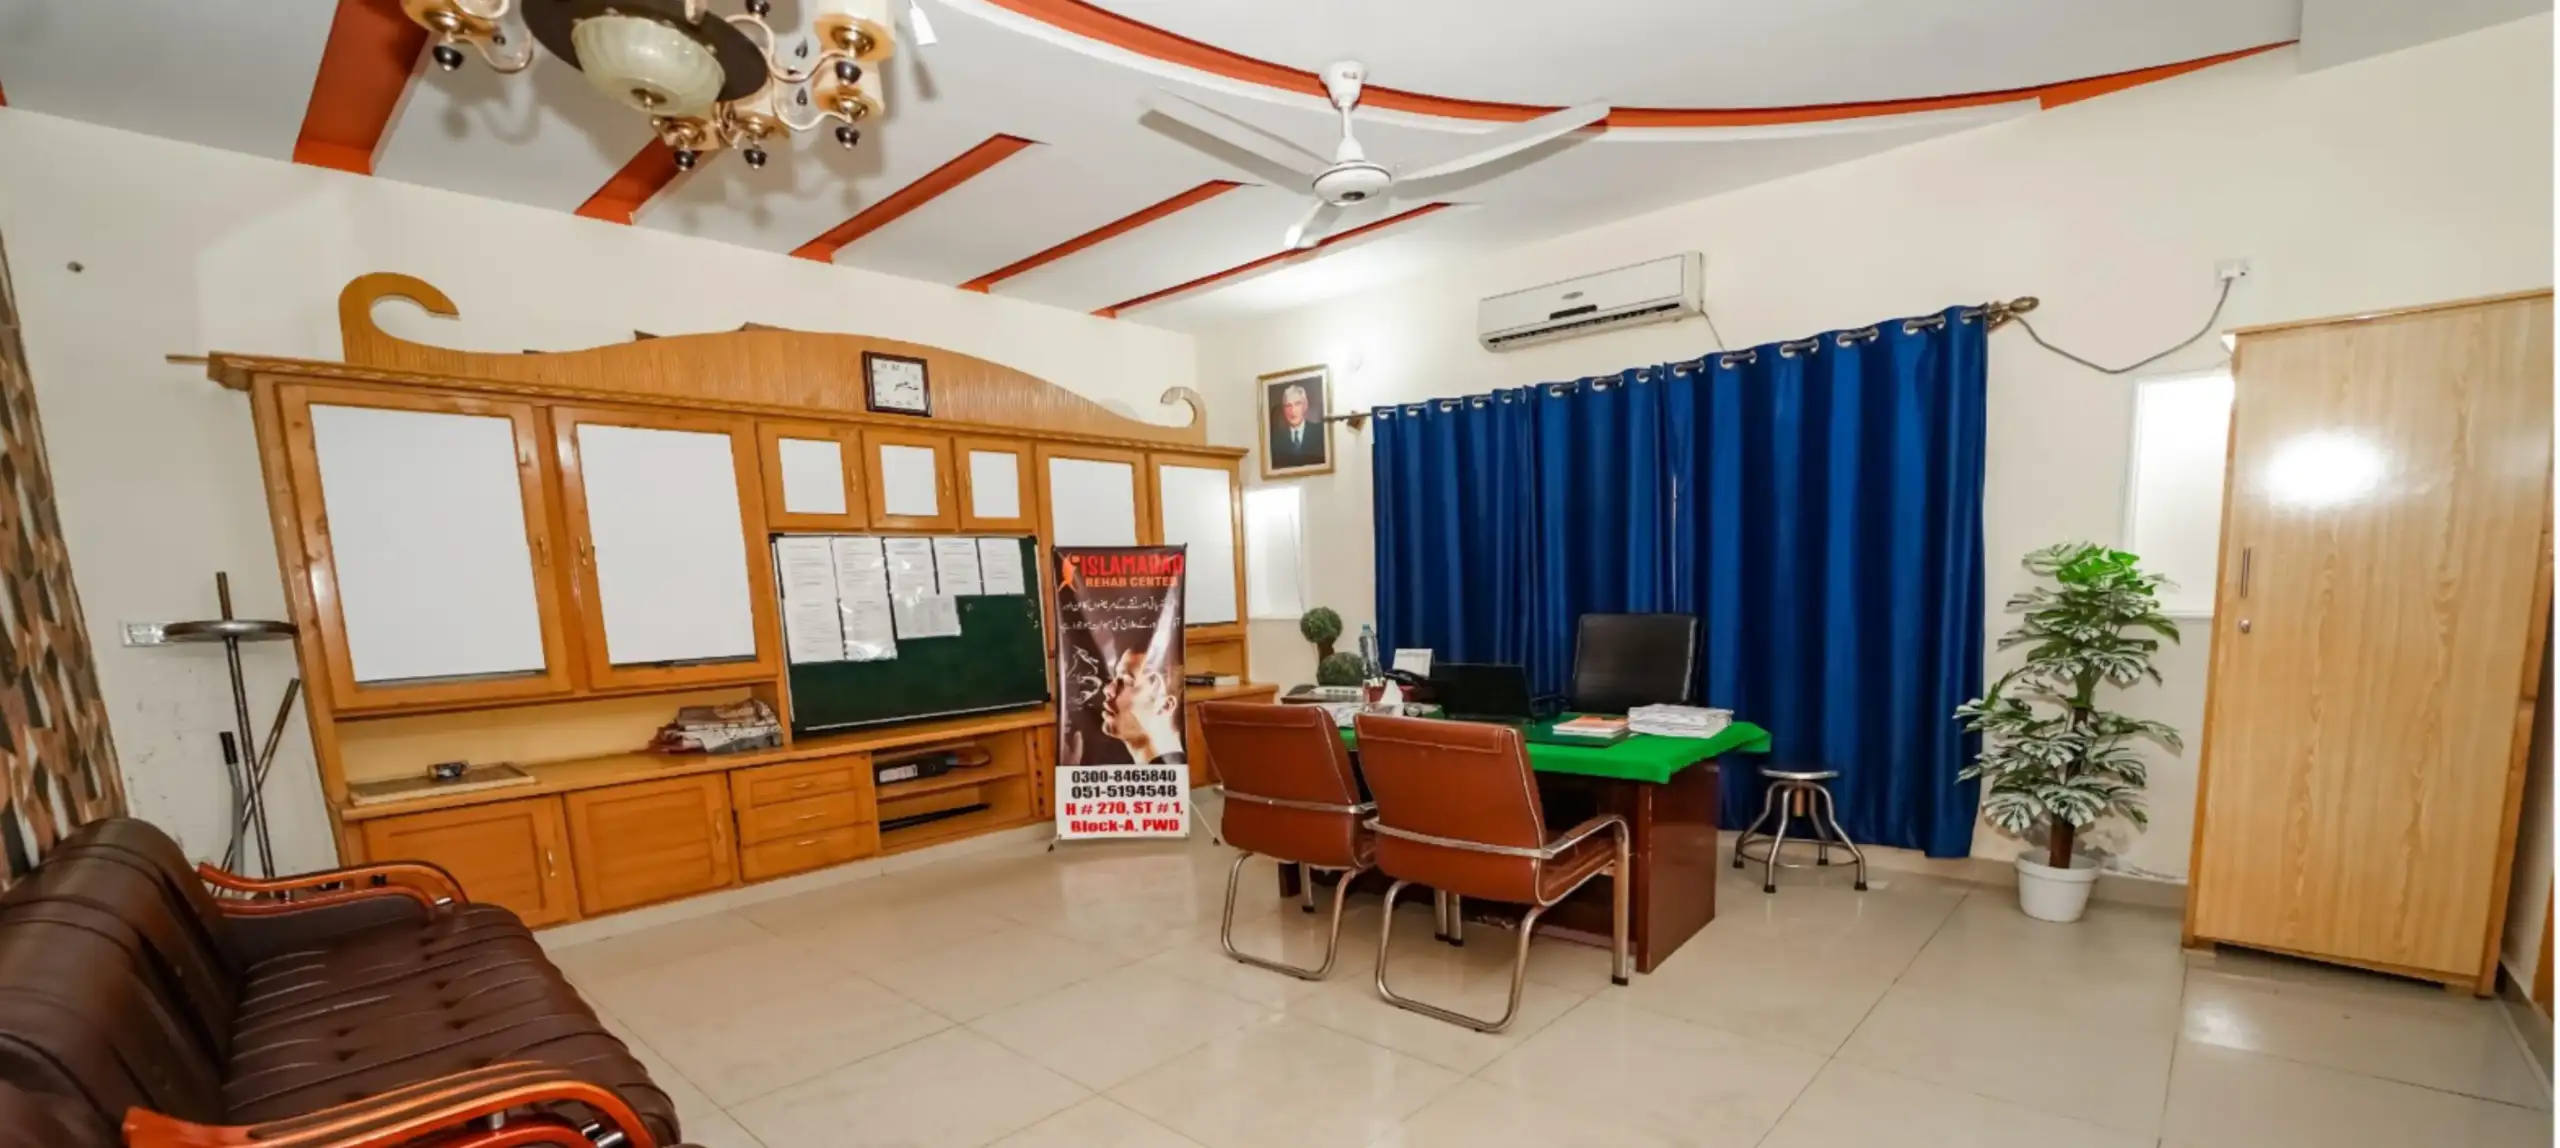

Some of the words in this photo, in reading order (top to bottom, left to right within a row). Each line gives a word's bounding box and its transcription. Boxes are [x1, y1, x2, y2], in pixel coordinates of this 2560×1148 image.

[1081, 553, 1184, 576] ISLAMABAD
[1085, 576, 1127, 588] REHAB
[1130, 576, 1178, 588] CENTER
[1071, 770, 1177, 783] 0300-8465840
[1071, 785, 1178, 799] 051-5194548
[1065, 803, 1077, 815] H
[1081, 804, 1093, 815] #
[1097, 801, 1130, 815] 270,
[1133, 801, 1153, 814] ST
[1157, 803, 1169, 814] #
[1172, 801, 1184, 815] 1,
[1071, 819, 1139, 833] Block-A,
[1142, 819, 1180, 832] PWD
